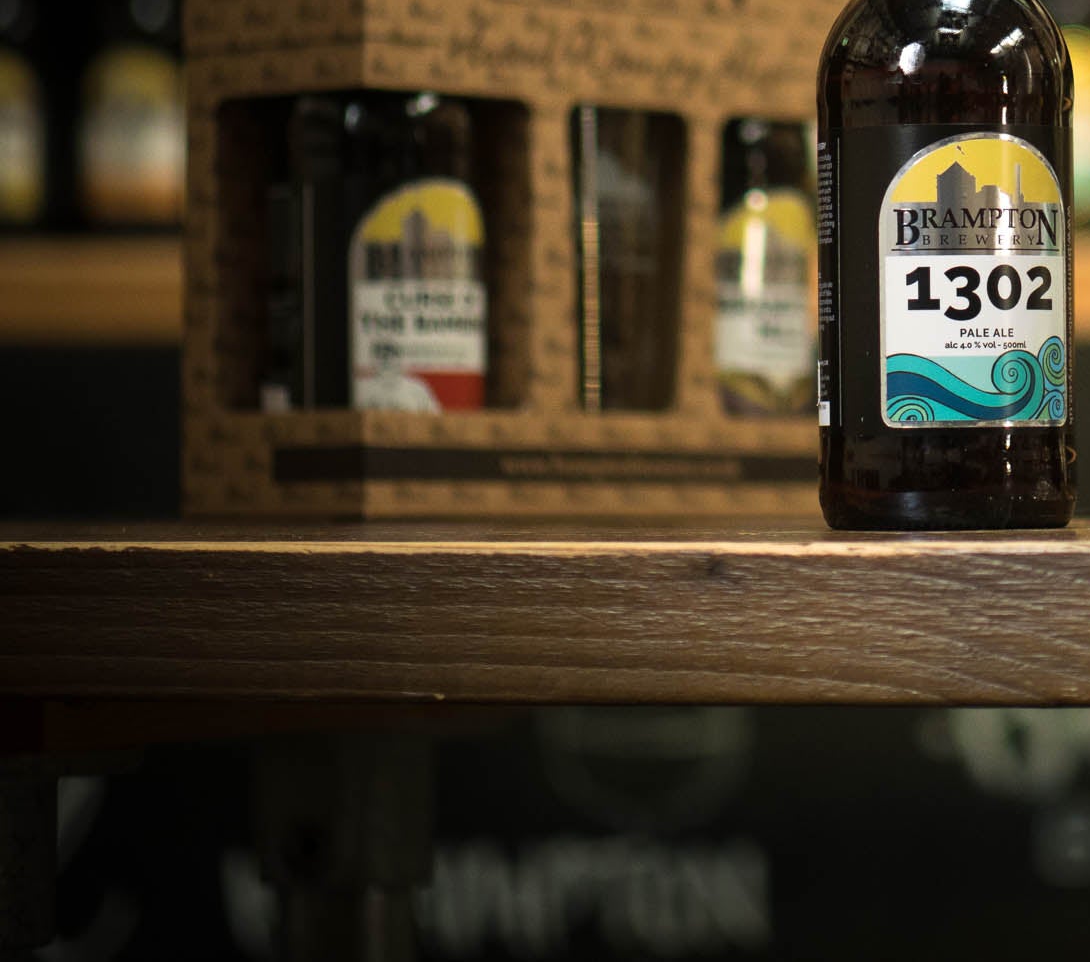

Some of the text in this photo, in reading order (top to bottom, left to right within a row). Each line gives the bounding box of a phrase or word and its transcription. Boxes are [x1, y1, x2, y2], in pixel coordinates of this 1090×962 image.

[893, 208, 1059, 246] BRAMPTON
[922, 234, 1036, 245] BREWERY
[905, 264, 1053, 321] 1302
[959, 328, 1015, 338] PALE ALE
[944, 341, 958, 349] alc
[960, 342, 973, 350] 4.0
[974, 341, 981, 349] %
[982, 341, 996, 349] vol
[1003, 341, 1027, 350] 500ml
